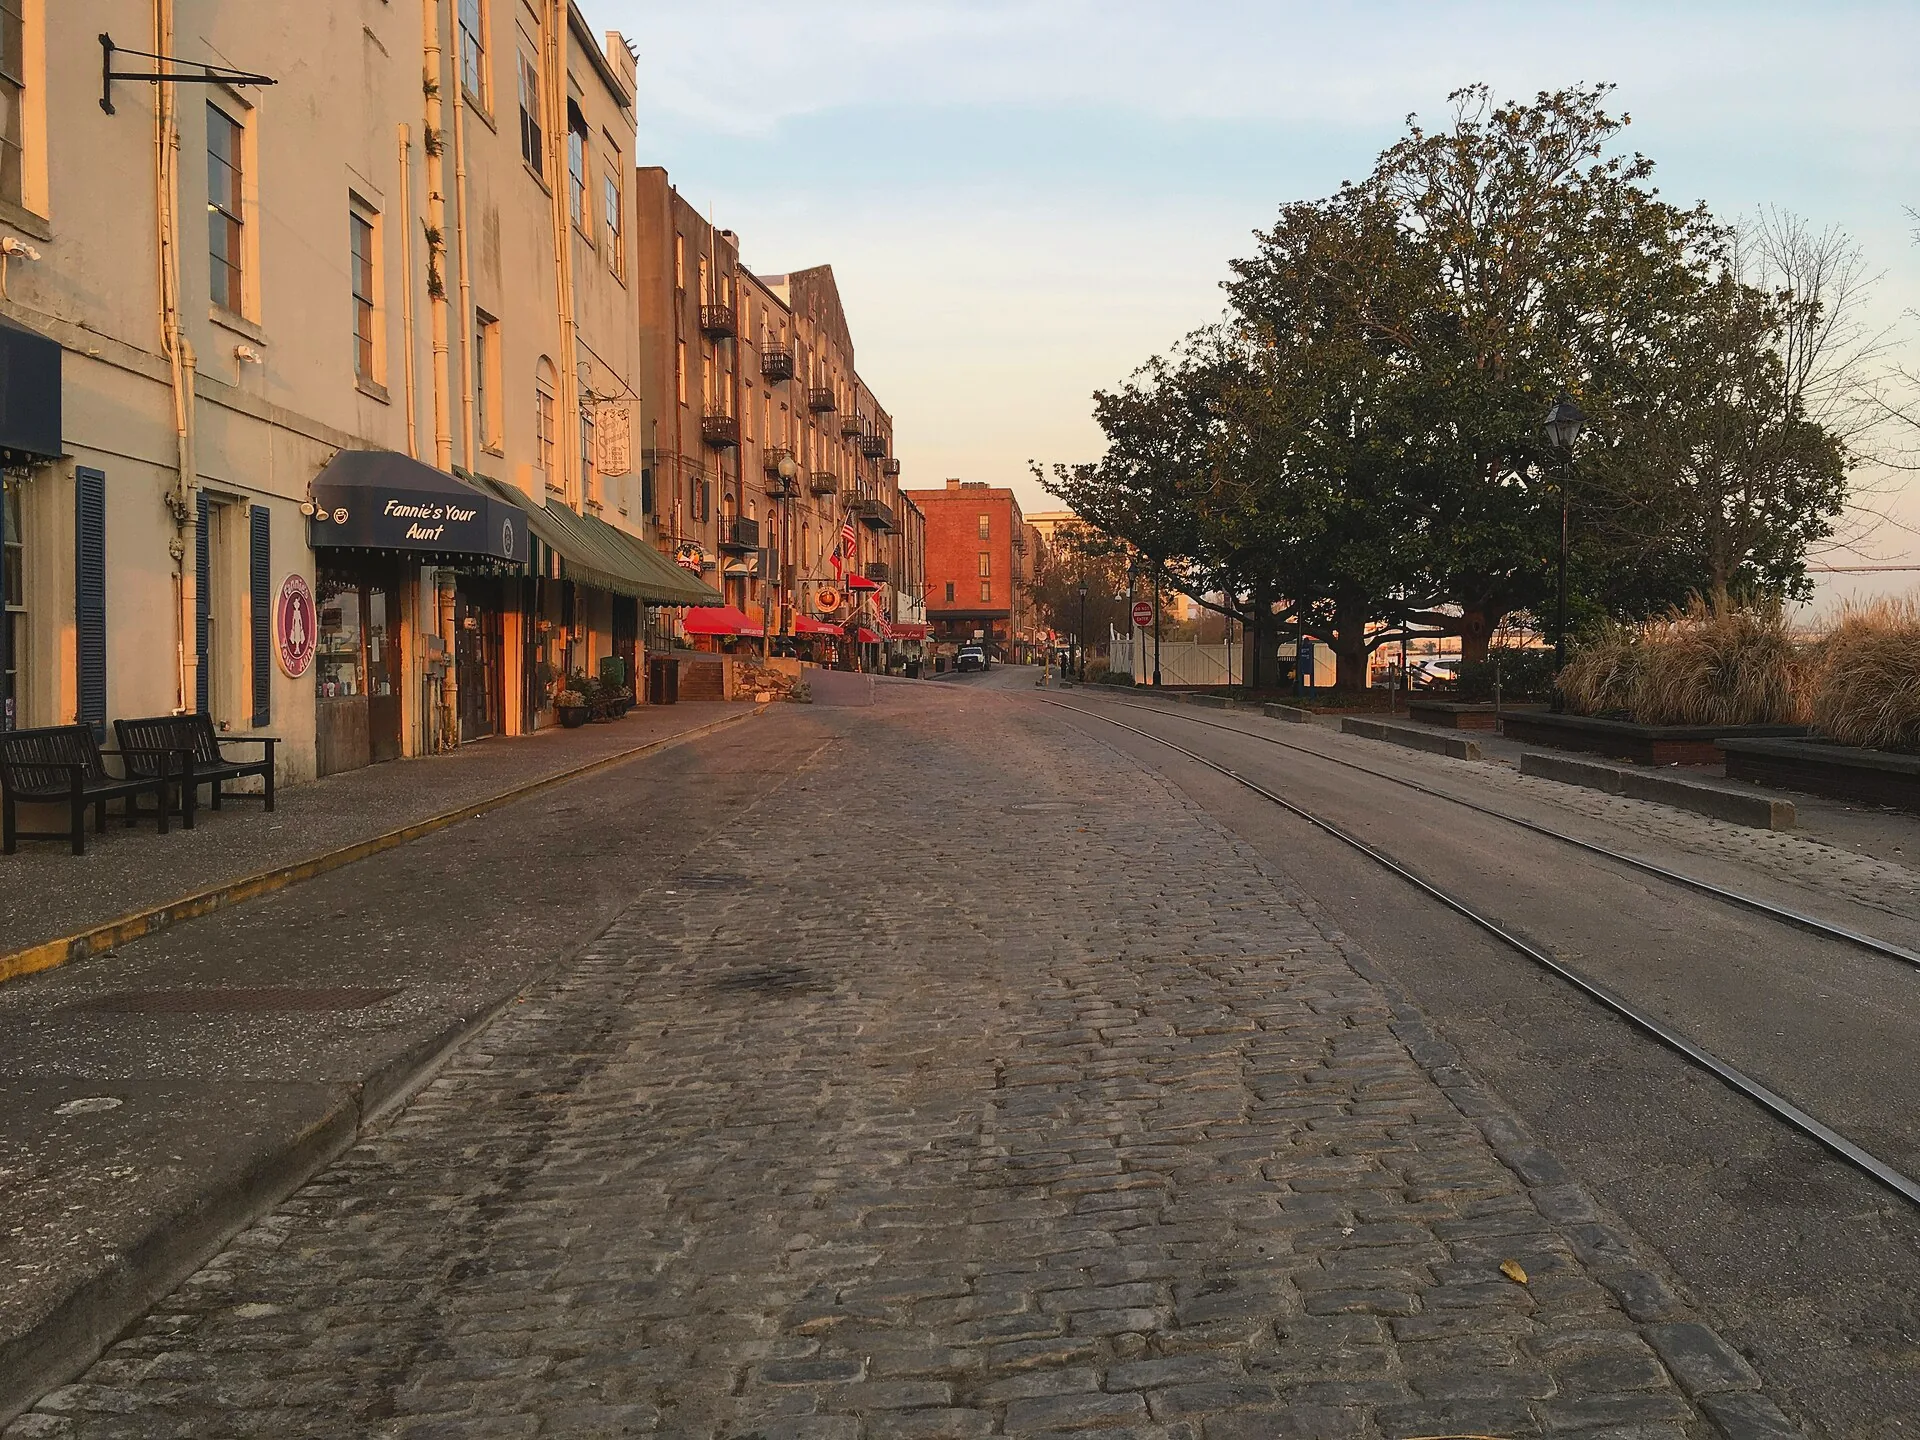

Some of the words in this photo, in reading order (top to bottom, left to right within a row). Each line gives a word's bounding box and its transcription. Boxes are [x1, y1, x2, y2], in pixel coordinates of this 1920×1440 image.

[384, 500, 443, 519] Fannie's
[445, 505, 476, 521] Your
[406, 523, 444, 541] Aunt
